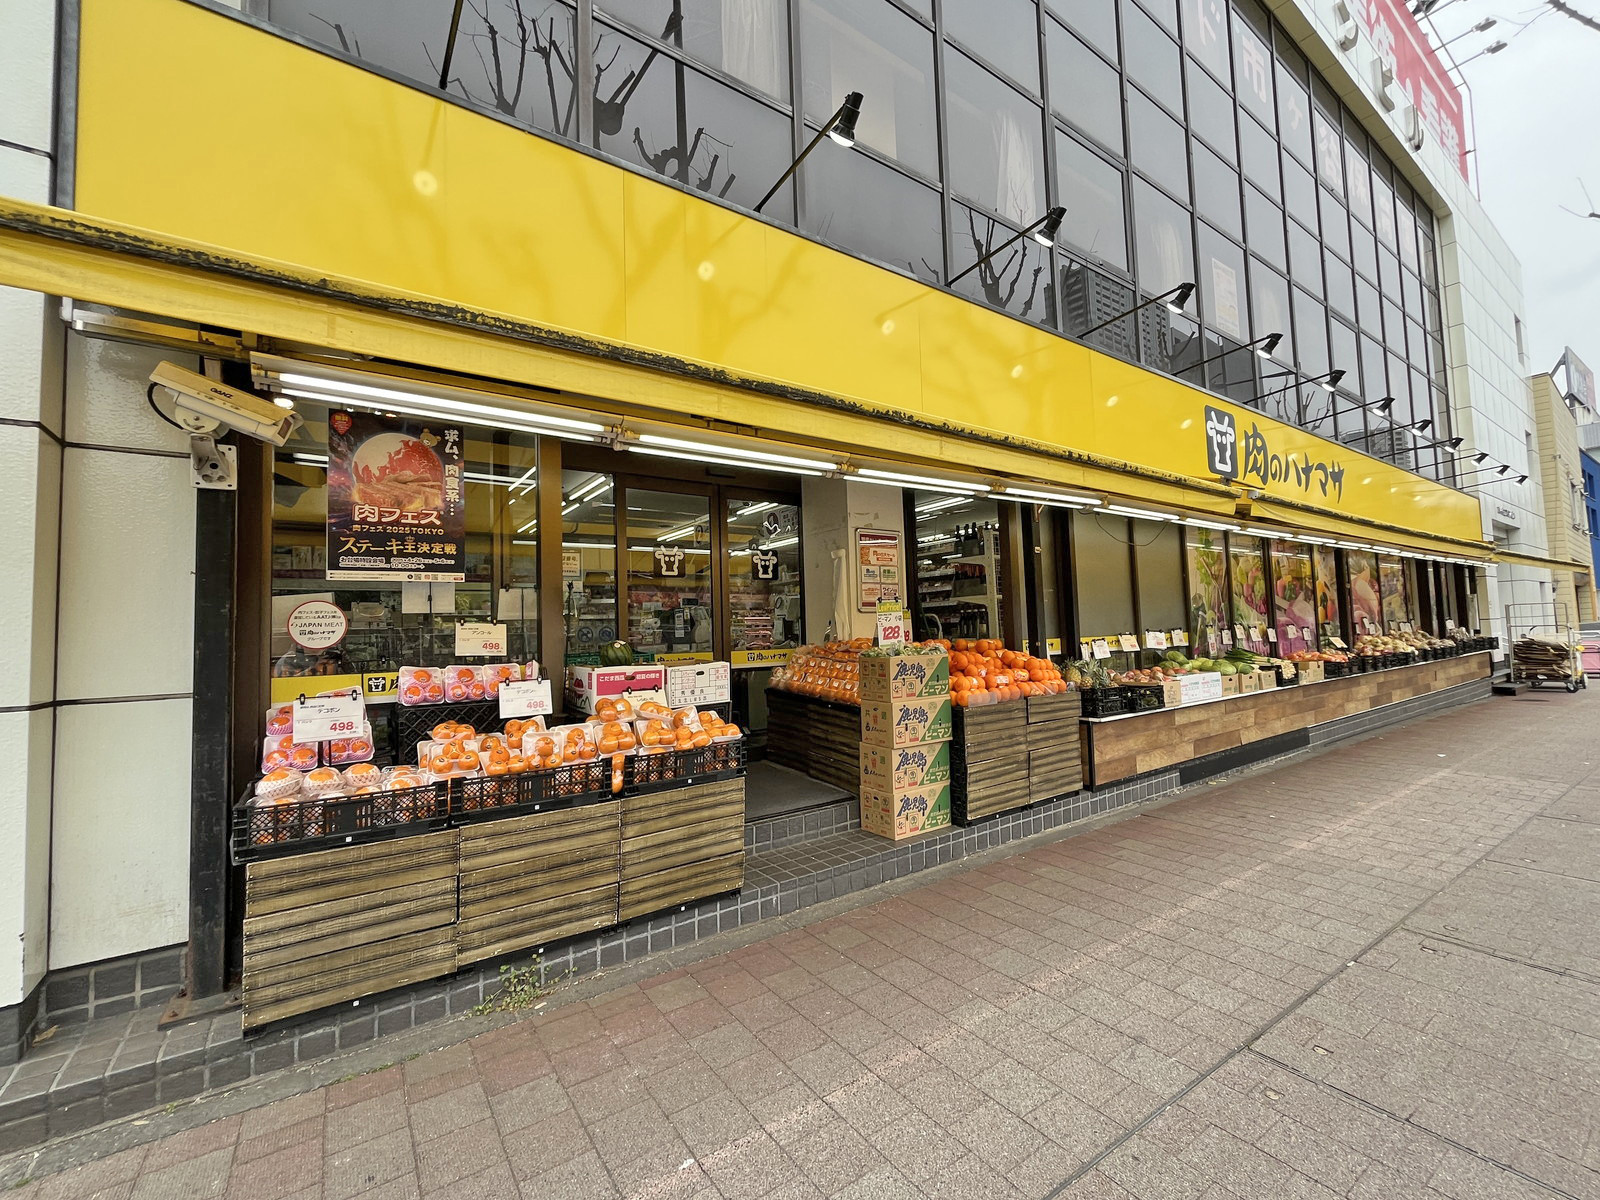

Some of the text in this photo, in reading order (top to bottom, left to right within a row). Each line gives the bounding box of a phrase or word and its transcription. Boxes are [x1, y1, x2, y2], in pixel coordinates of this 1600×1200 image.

[1242, 421, 1346, 505] 肉のハナマサ
[353, 503, 442, 527] 肉フェス
[411, 527, 445, 536] TOKYO
[337, 535, 458, 556] ステーキ王決定戦
[882, 625, 901, 641] 128
[482, 642, 500, 650] 498
[892, 659, 927, 685] 鹿児島
[922, 684, 949, 696] ピーマン
[526, 701, 545, 709] 498
[895, 704, 929, 729] 鹿児島
[329, 721, 354, 732] 498
[925, 728, 952, 740] ピーマン
[895, 749, 928, 773] 鹿児島
[923, 770, 950, 784] ピーマン
[896, 794, 928, 817] 鹿児島
[924, 814, 950, 828] ピーマン
